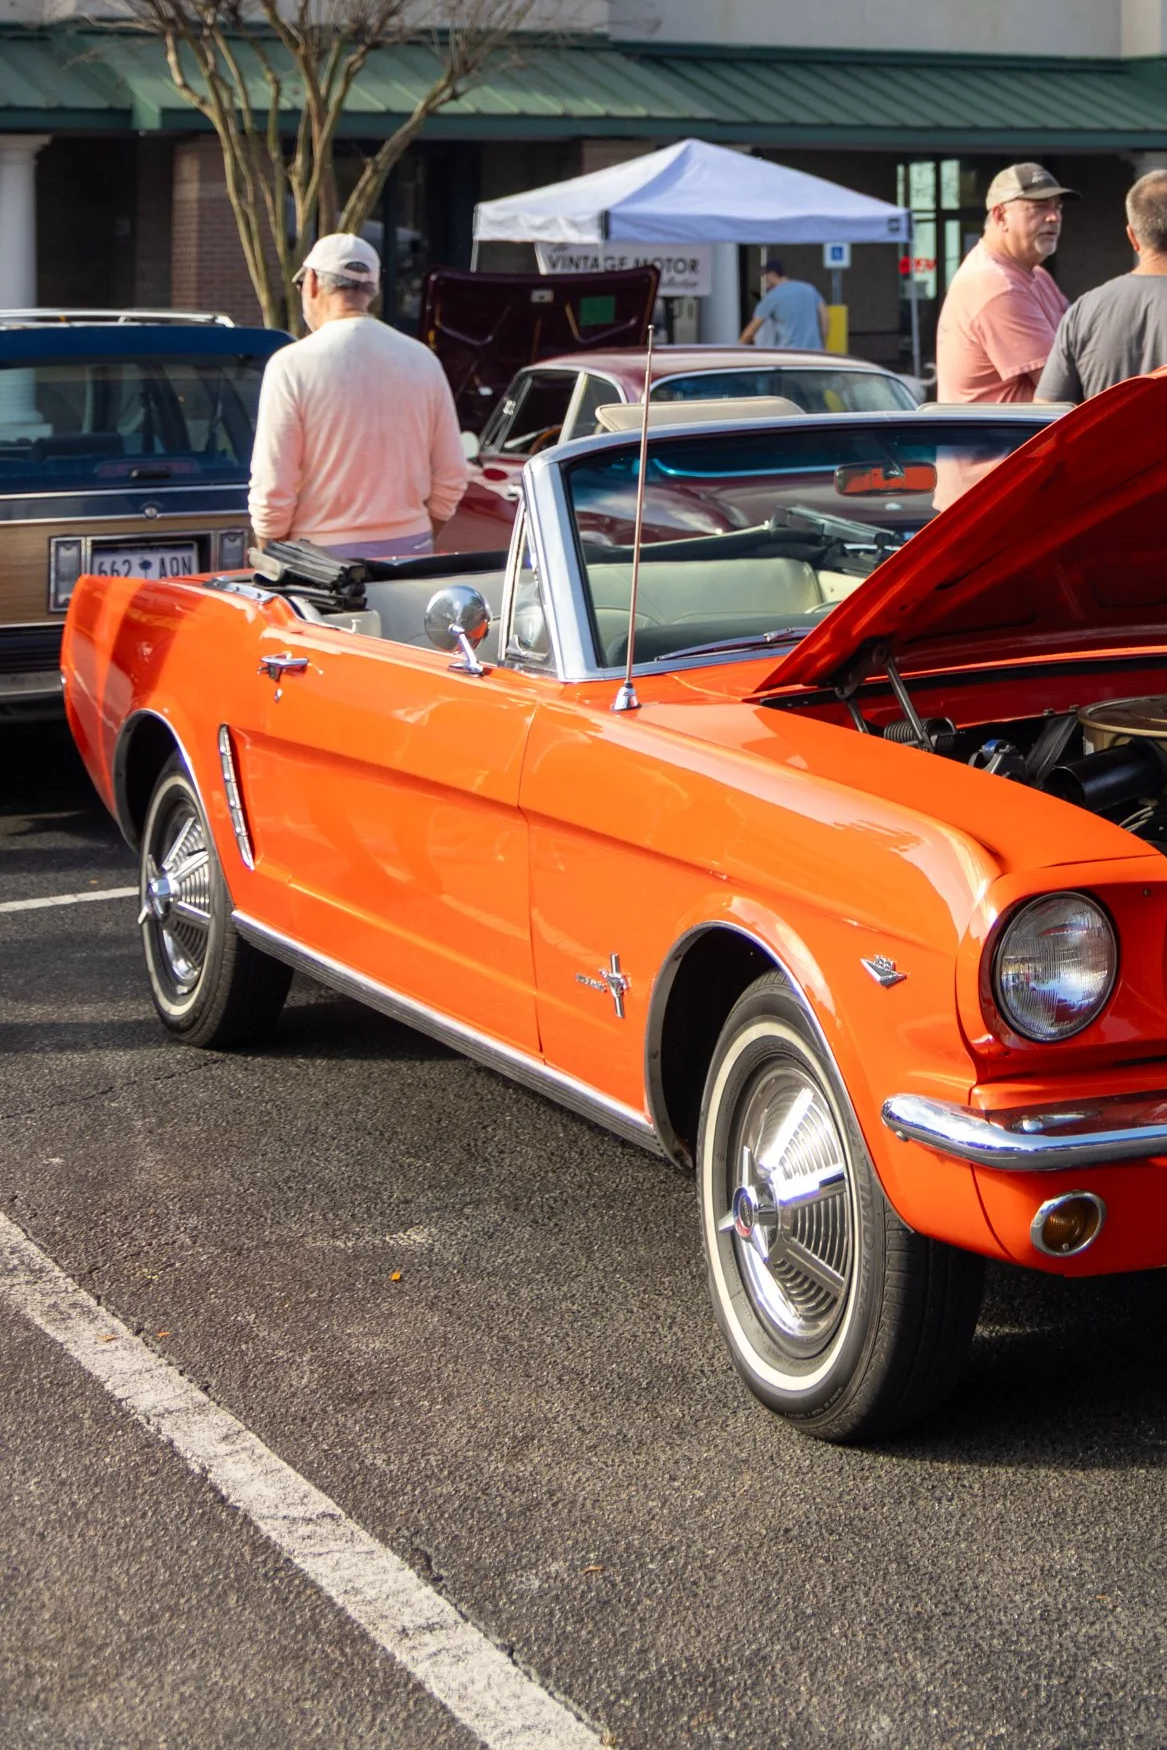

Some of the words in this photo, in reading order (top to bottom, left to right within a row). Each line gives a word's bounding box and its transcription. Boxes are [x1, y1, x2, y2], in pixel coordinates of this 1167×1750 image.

[547, 254, 627, 272] VINTAGE
[634, 256, 700, 275] MOTOR
[97, 559, 132, 578] 662
